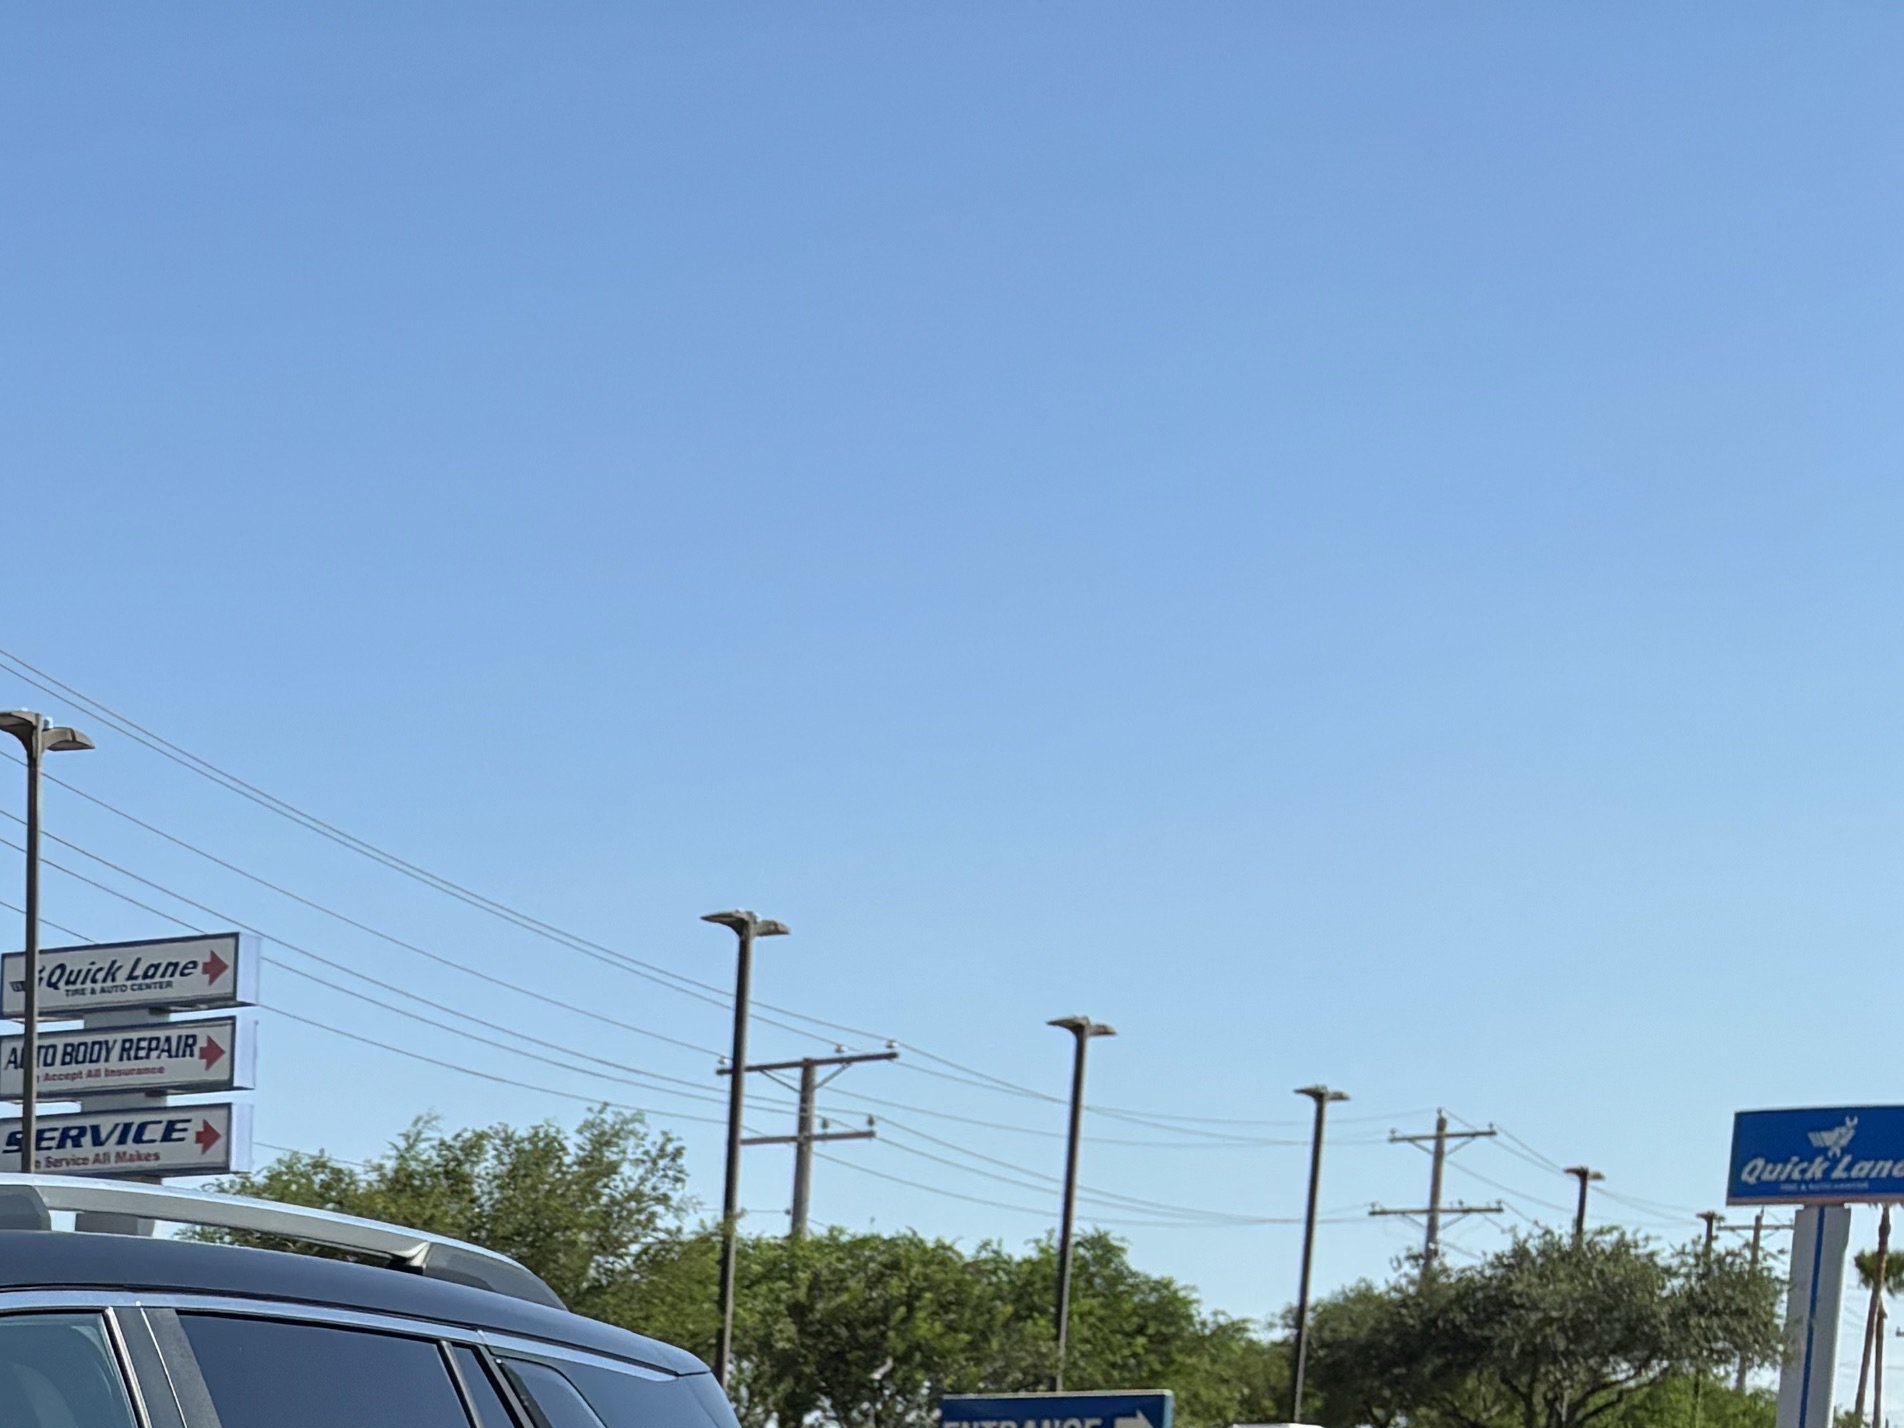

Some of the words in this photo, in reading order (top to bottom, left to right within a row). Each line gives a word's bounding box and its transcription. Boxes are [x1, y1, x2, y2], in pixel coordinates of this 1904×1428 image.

[46, 958, 123, 990] Quick
[125, 957, 198, 981] Lane
[99, 984, 128, 994] AUTO
[130, 980, 174, 992] CENTER
[3, 1044, 58, 1070] ATO
[60, 1039, 117, 1066] BODY
[118, 1034, 197, 1062] REPAIR
[43, 1070, 84, 1082] Accept
[85, 1068, 102, 1079] All
[104, 1066, 166, 1078] Insurance
[2, 1118, 193, 1154] SERVICE
[44, 1156, 90, 1168] Service
[92, 1152, 112, 1165] All
[114, 1151, 161, 1164] Makes
[1740, 1154, 1831, 1185] Quick
